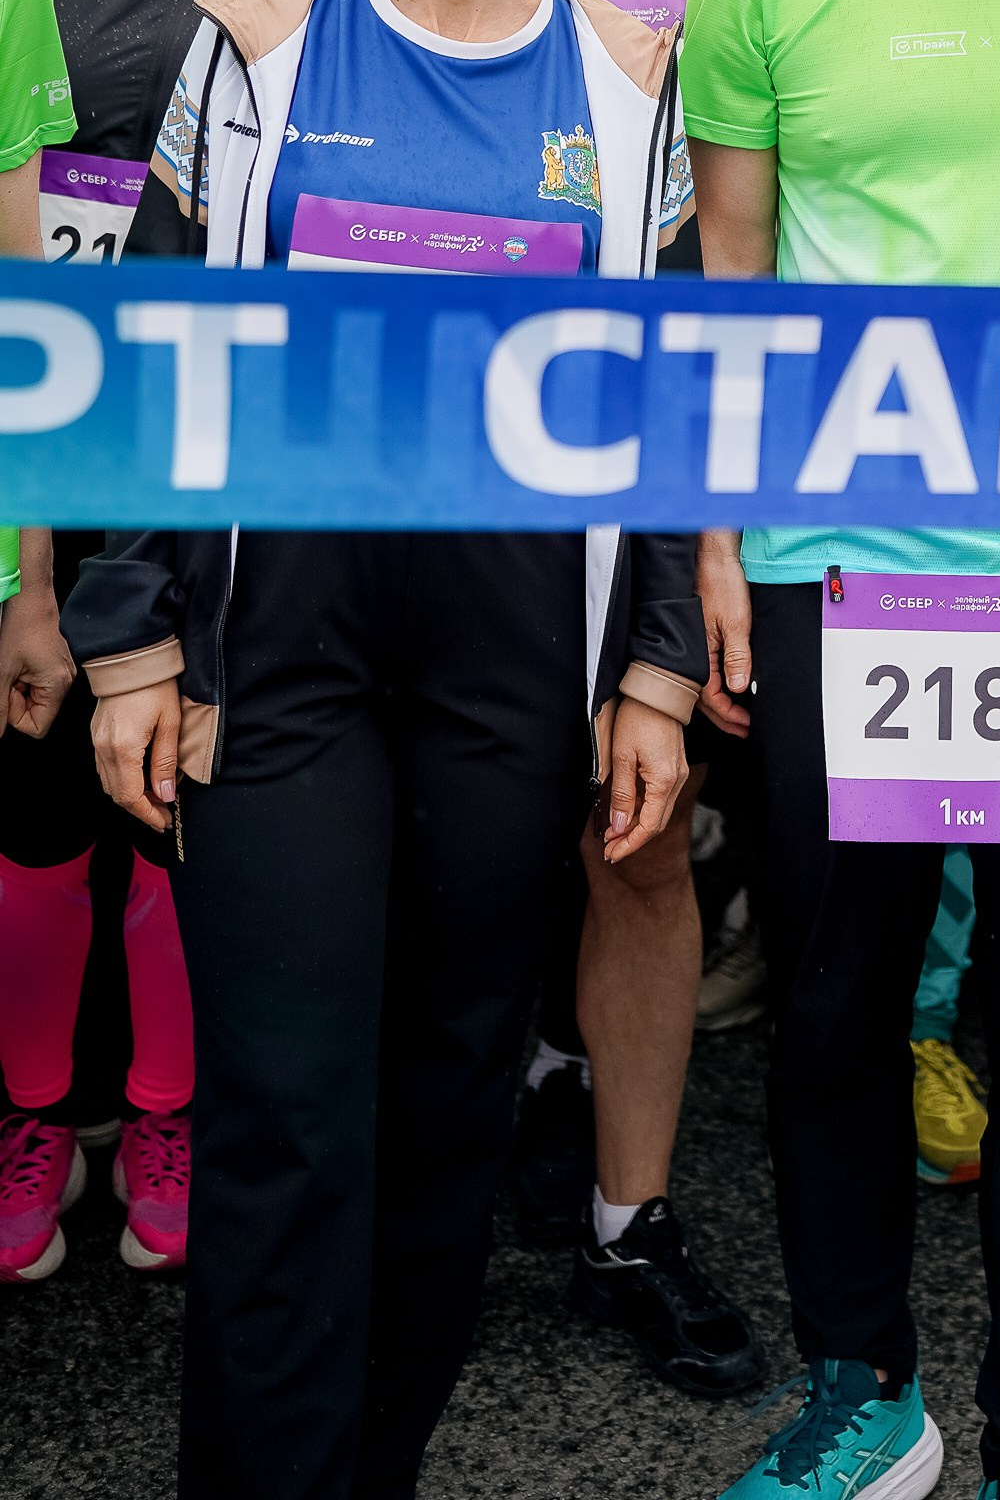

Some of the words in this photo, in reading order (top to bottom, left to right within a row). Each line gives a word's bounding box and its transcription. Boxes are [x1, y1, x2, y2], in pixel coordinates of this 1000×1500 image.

[913, 38, 955, 51] Прайм
[302, 131, 375, 147] proteam
[81, 173, 107, 185] СБЕР
[368, 229, 407, 242] СБЕР
[429, 233, 467, 242] зелёный
[423, 240, 462, 250] марафон
[898, 598, 933, 609] СБЕР
[954, 595, 990, 604] зелёный
[950, 604, 987, 613] марафон
